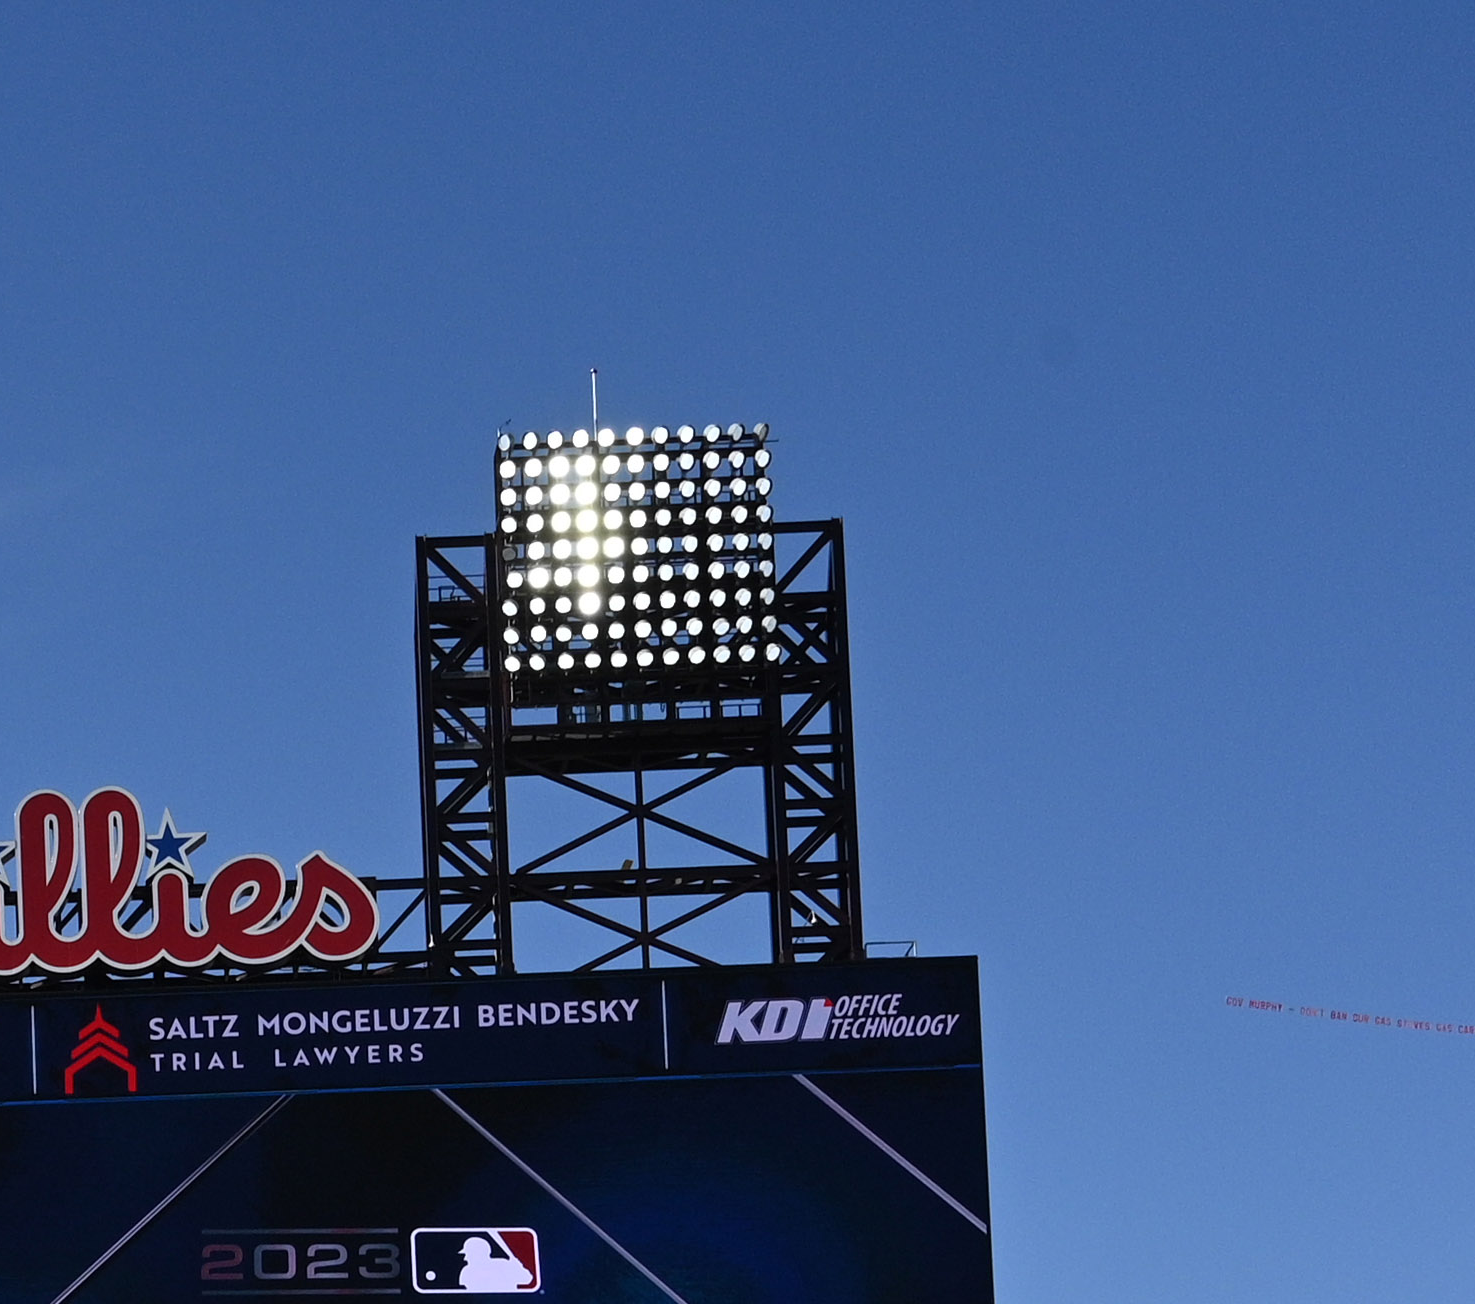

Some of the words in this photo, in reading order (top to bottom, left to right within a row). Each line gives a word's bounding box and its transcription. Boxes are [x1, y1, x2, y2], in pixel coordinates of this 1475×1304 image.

[149, 1014, 240, 1041] SALTZ
[257, 1006, 460, 1036] MONGELUZZI
[477, 998, 639, 1028] BENDESKY
[718, 998, 832, 1043] KDI
[834, 993, 903, 1017] OFFICE
[830, 1013, 960, 1041] TECHNOLOGY
[150, 1049, 244, 1073] TRIAL
[275, 1042, 424, 1067] LAWYERS
[201, 1243, 400, 1281] 2023
